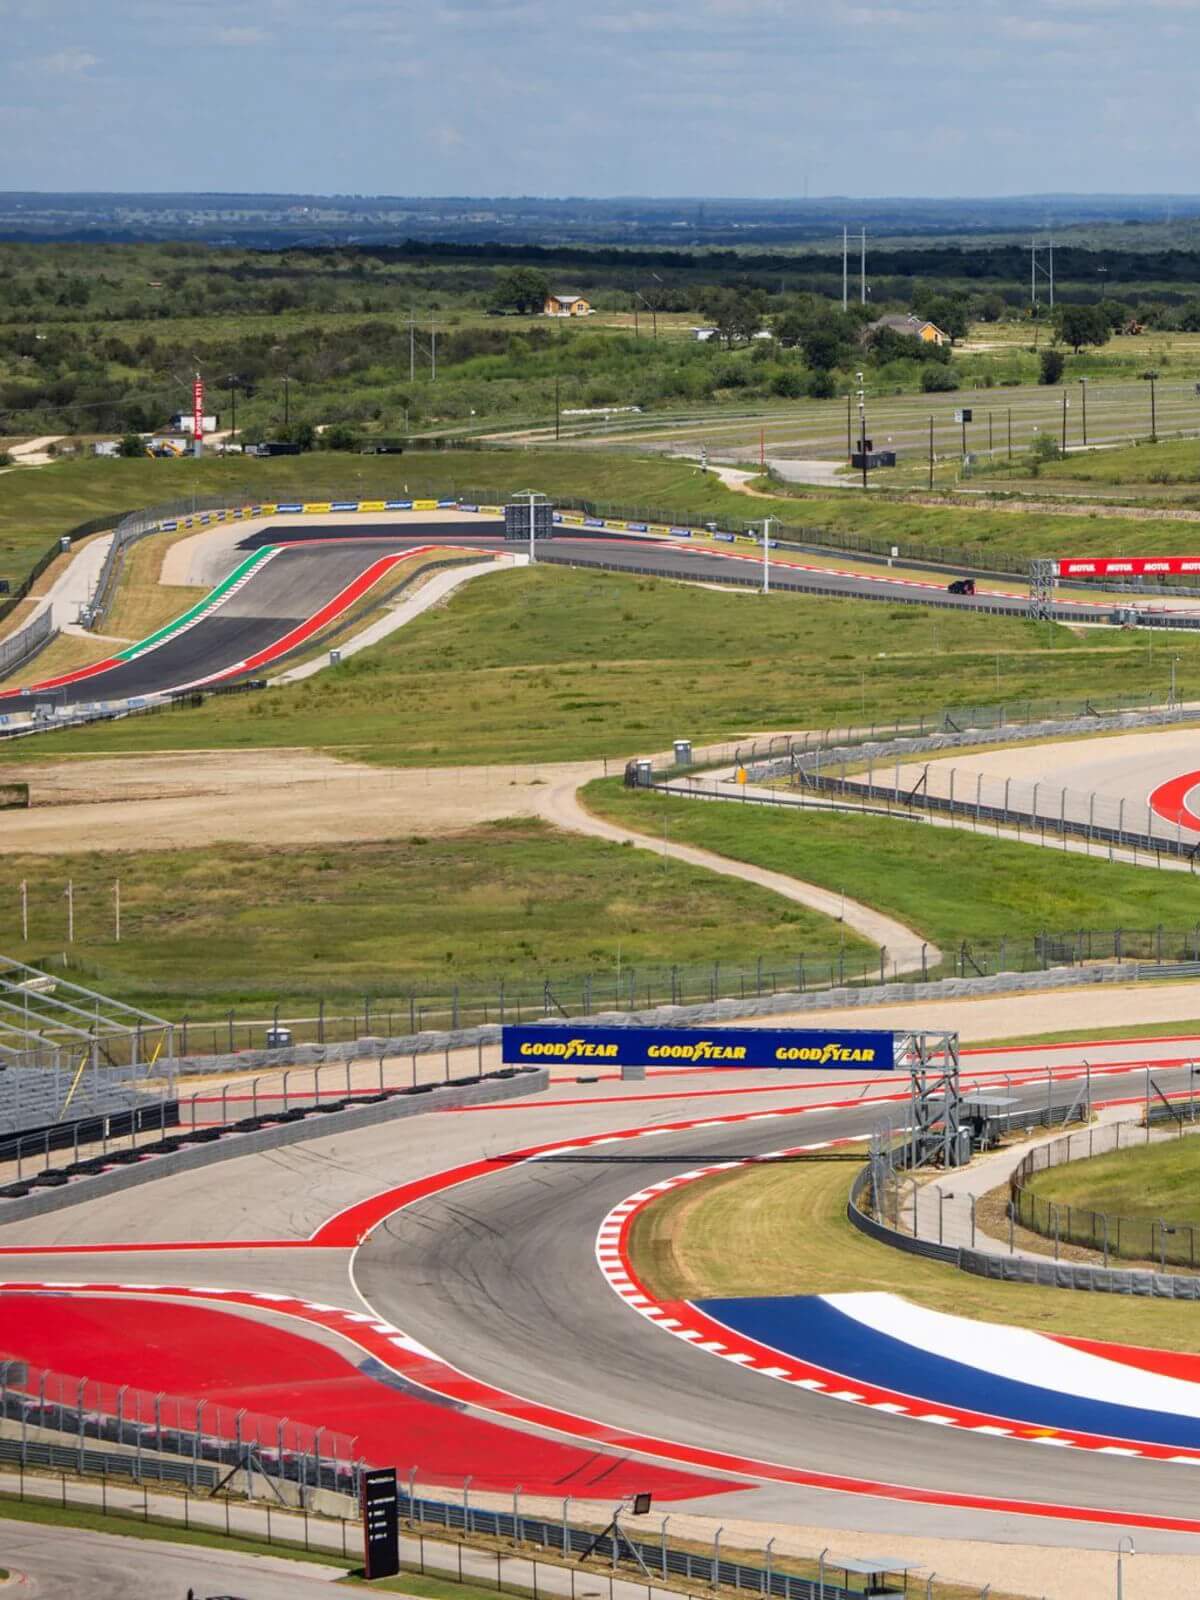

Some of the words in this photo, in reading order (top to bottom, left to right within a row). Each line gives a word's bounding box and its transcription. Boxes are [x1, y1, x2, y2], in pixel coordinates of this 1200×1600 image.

[520, 1039, 619, 1060] GOODYEAR
[647, 1041, 747, 1062] GOODYEAR
[775, 1043, 875, 1064] GOODYEAR
